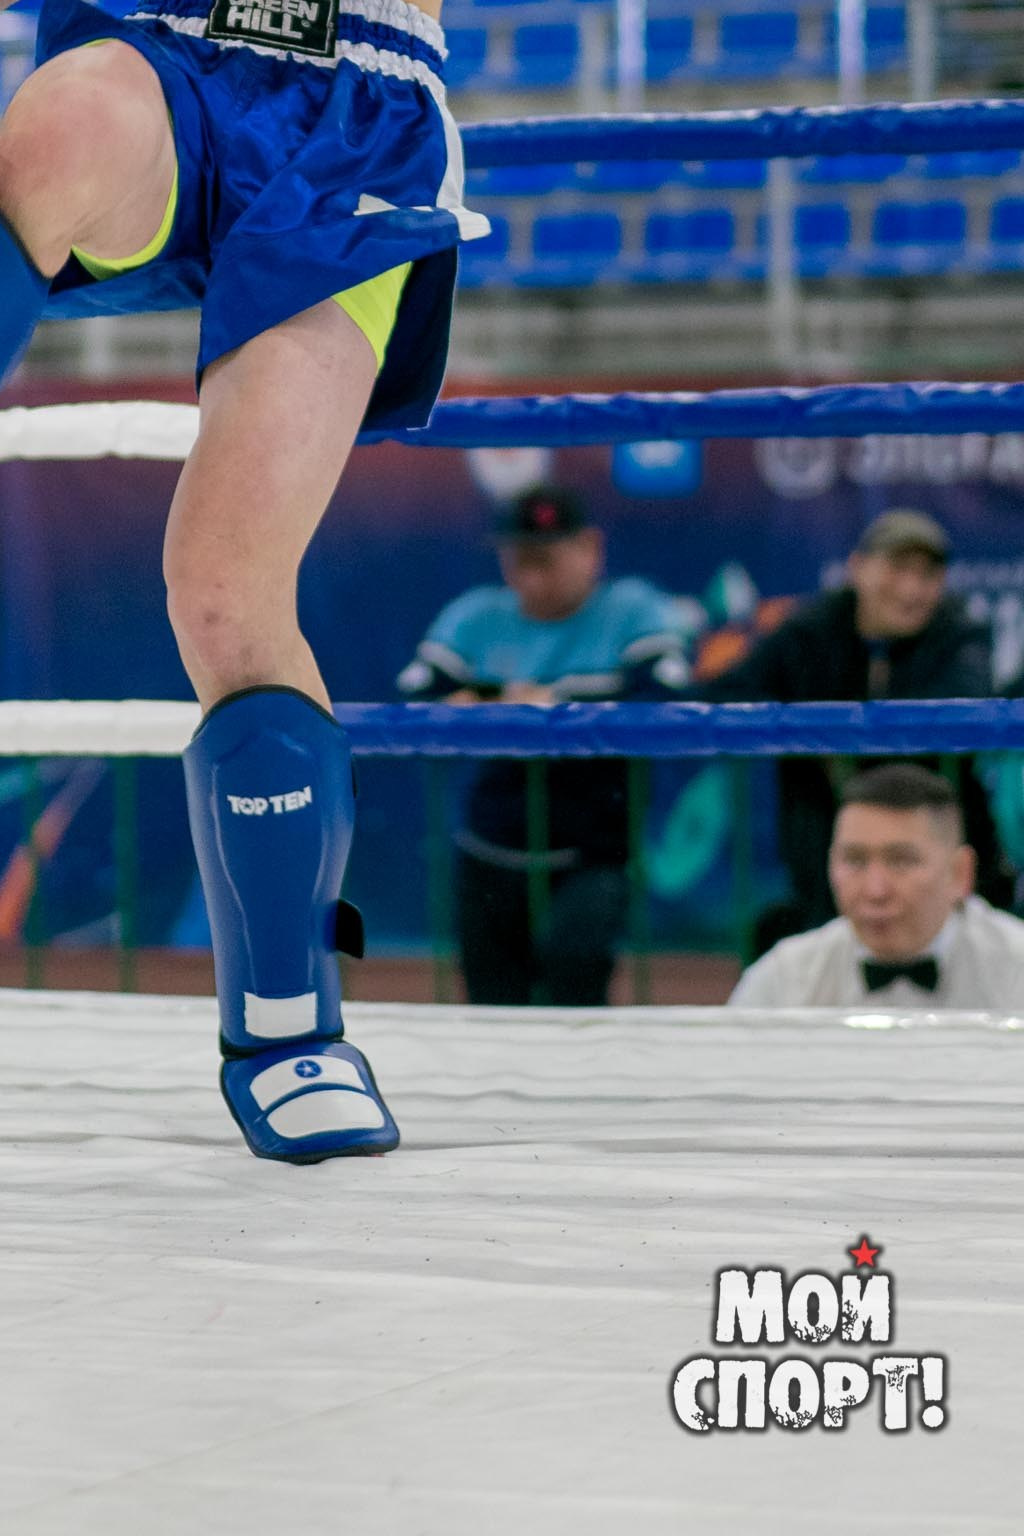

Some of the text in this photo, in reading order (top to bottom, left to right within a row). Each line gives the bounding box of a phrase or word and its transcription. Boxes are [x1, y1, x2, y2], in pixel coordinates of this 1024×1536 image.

[226, 5, 303, 39] HILL
[226, 785, 313, 816] TOP TEN
